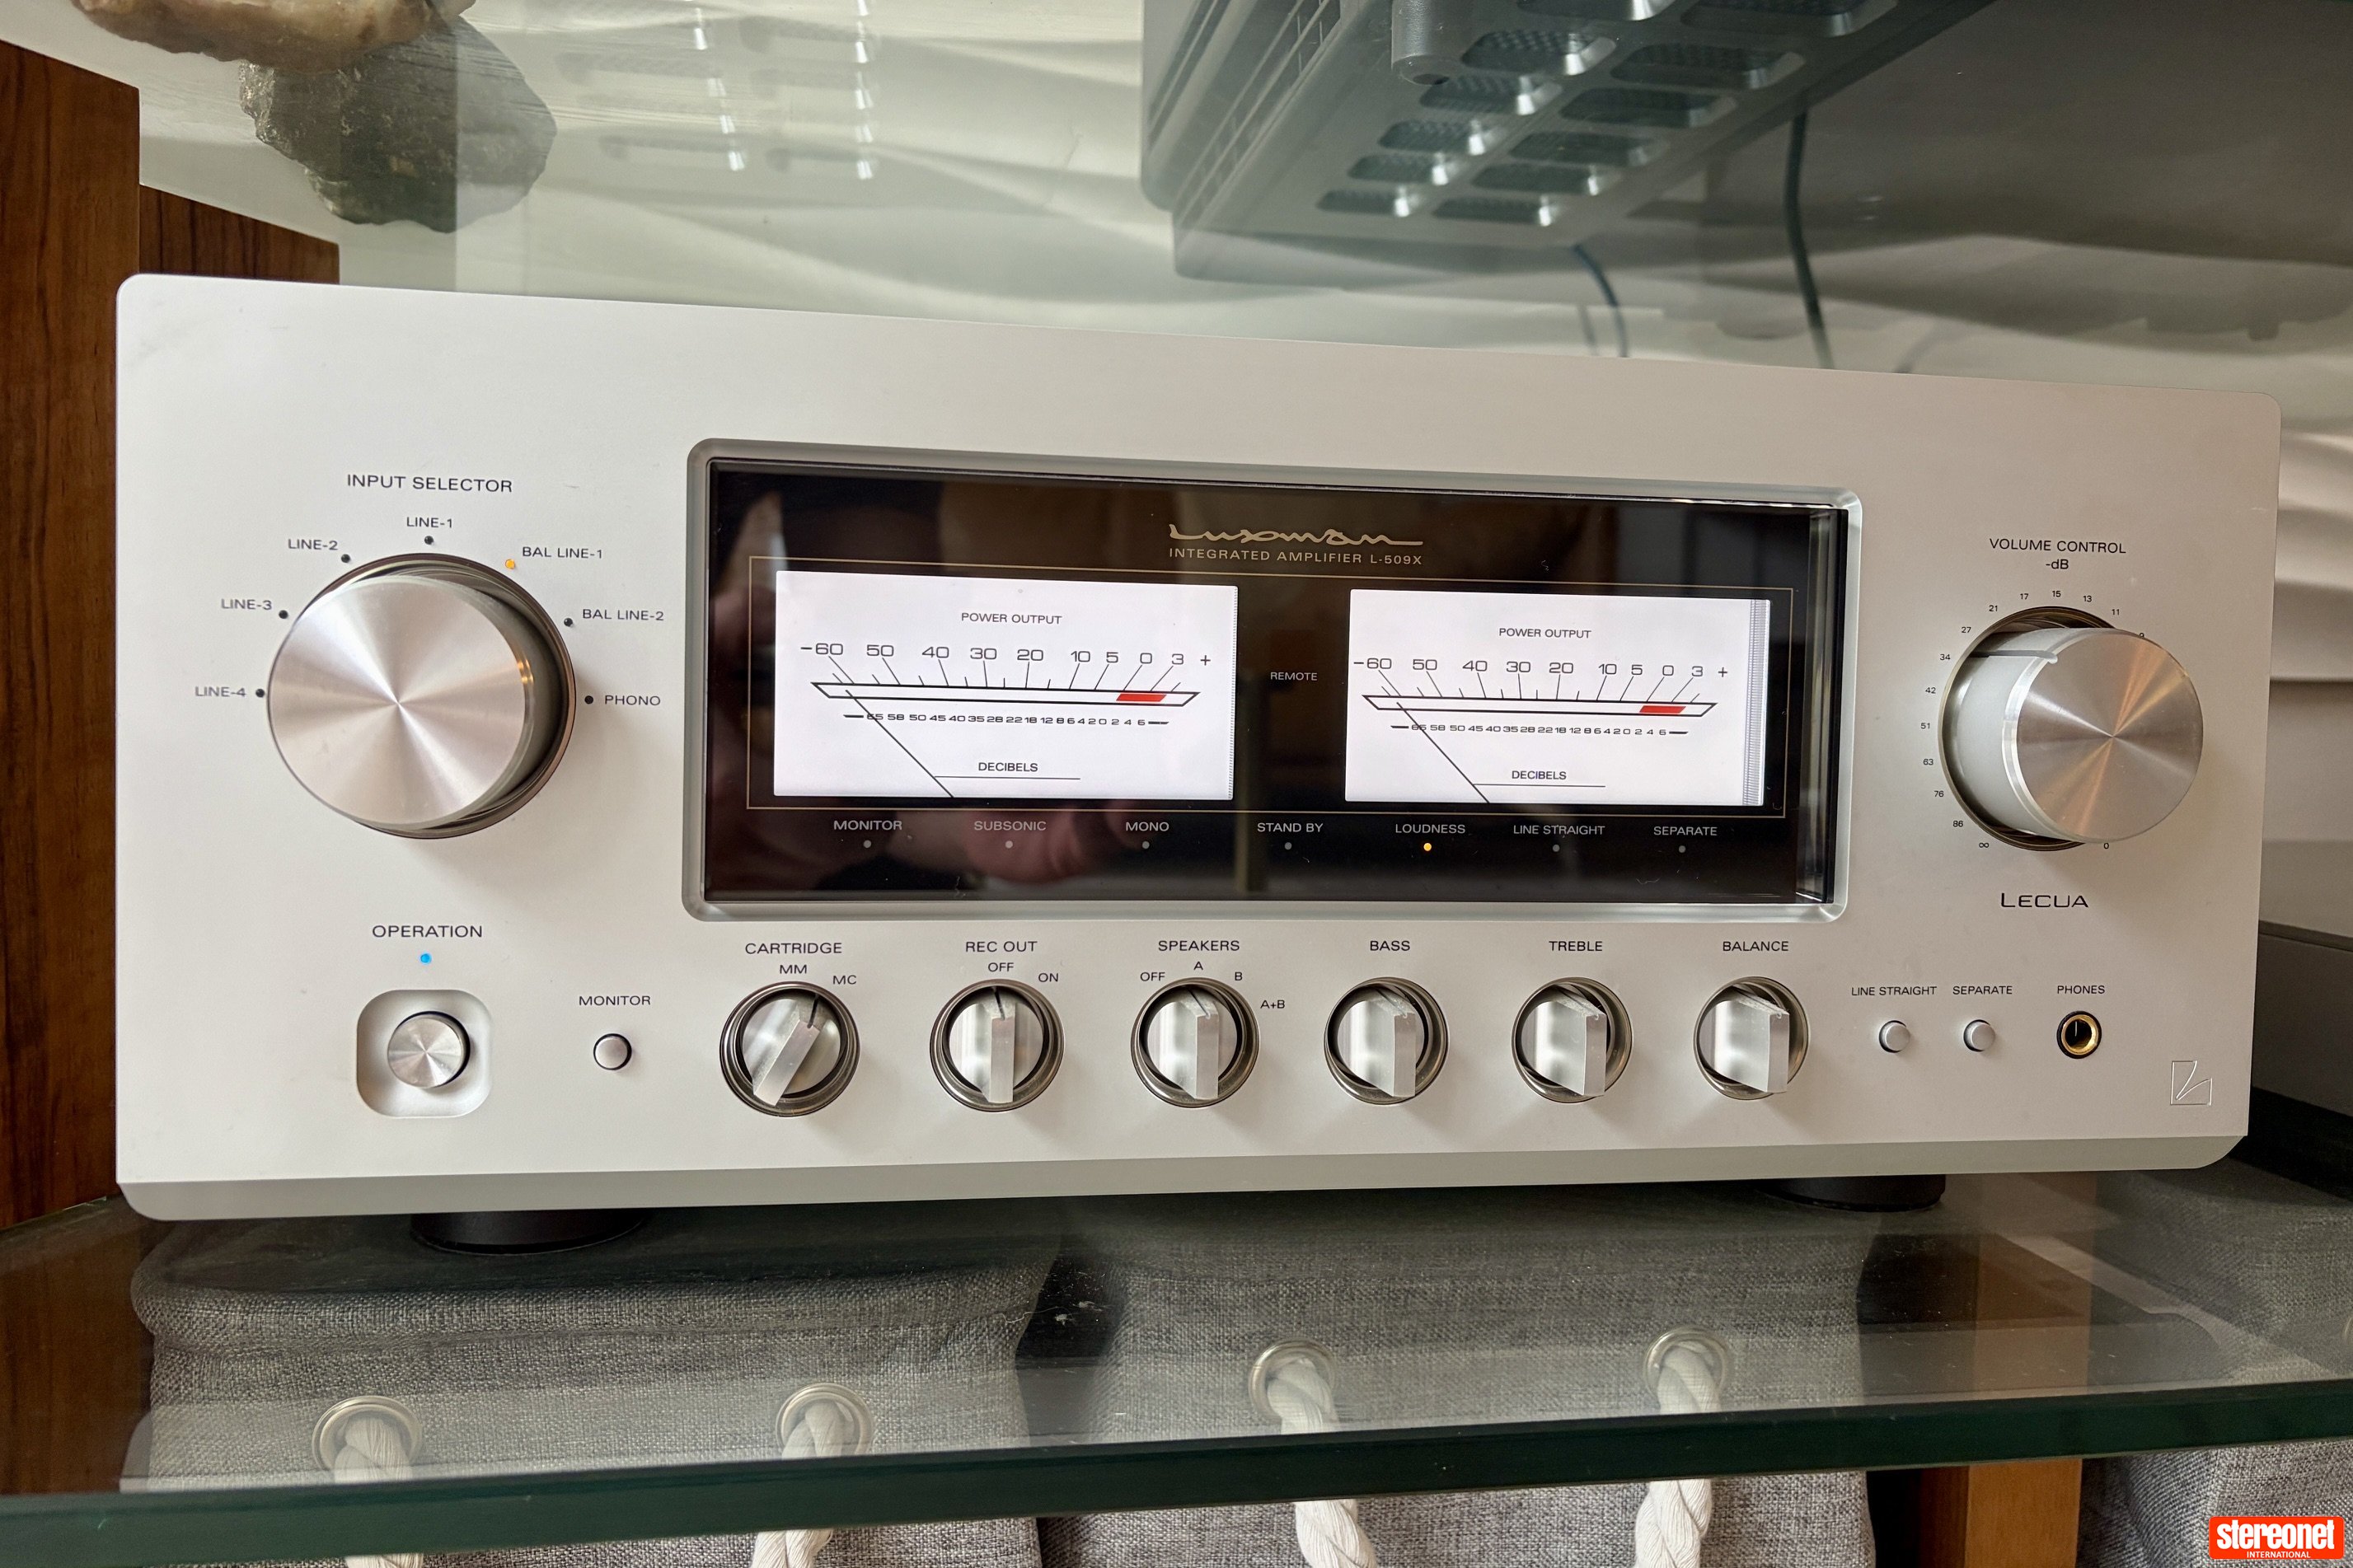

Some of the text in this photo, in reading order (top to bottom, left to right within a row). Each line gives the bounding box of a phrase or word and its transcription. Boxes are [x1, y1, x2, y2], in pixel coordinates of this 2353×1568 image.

[348, 475, 512, 492] INPUT SELECTOR
[406, 517, 452, 528] LINE-1
[288, 538, 338, 551] LINE-2
[1989, 538, 2126, 554] VOLUME CONTROL
[522, 546, 602, 559] BAL LINE-1
[1169, 548, 1422, 565] INTEGRATED AMPLIFIER L-509X
[2045, 559, 2069, 570] -dB
[2019, 592, 2029, 601] 17
[2051, 590, 2062, 598] 15
[2083, 595, 2093, 603] 13
[221, 598, 272, 611] LINE-3
[1989, 604, 1998, 612] 21
[582, 608, 664, 621] BAL LINE-2
[961, 612, 1062, 625] POWER OUTPUT
[1498, 627, 1592, 639] POWER OUTPUT
[866, 644, 894, 658] 50
[921, 646, 949, 659] 40
[969, 647, 997, 660] 30
[1016, 648, 1044, 662] 20
[1070, 650, 1091, 662] 10
[1105, 651, 1119, 663] 5
[1139, 652, 1153, 665] 0
[1171, 653, 1184, 666] 3
[1412, 658, 1438, 671] 50
[1462, 660, 1488, 672] 40
[1506, 661, 1531, 673] 30
[1549, 662, 1574, 674] 20
[1598, 663, 1617, 675] 10
[1631, 664, 1643, 676] 5
[1662, 664, 1675, 676] 0
[1691, 665, 1704, 677] 3
[1270, 672, 1318, 681] REMOTE
[195, 686, 246, 698] LINE-4
[1924, 686, 1936, 695] 42
[604, 695, 661, 706] PHONO
[909, 714, 927, 722] 50
[987, 715, 1004, 723] 28
[1024, 716, 1038, 724] 18
[1537, 726, 1554, 734] 22
[1920, 722, 1930, 730] 51
[978, 761, 1038, 773] DECIBELS
[1923, 758, 1934, 766] 63
[1512, 770, 1567, 780] DECIBELS
[833, 820, 902, 831] MONITOR
[973, 820, 1047, 831] SUBSONIC
[1125, 821, 1169, 832] MONO
[1257, 822, 1324, 833] STAND BY
[1395, 823, 1466, 834] LOUDNESS
[1952, 820, 1964, 828] 86
[1513, 824, 1605, 837] LINE STRAIGHT
[1653, 826, 1718, 836] SEPARATE
[2001, 893, 2088, 907] LECUA
[372, 924, 482, 938] OPERATION
[744, 942, 842, 955] CARTRIDGE
[965, 940, 1038, 953] REC OUT
[1158, 940, 1240, 952] SPEAKERS
[1370, 940, 1411, 952] BASS
[1548, 940, 1603, 952] TREBLE
[1723, 940, 1789, 952] BALANCE
[779, 964, 808, 975] MM
[987, 962, 1015, 972] OFF
[1193, 961, 1204, 971] A
[832, 974, 857, 985] MC
[1038, 972, 1059, 983] ON
[1140, 971, 1165, 982] OFF
[1234, 971, 1243, 981] B
[1851, 985, 1938, 996] LINE STRAIGHT
[1952, 985, 2013, 995] SEPARATE
[2057, 985, 2106, 995] PHONES
[579, 995, 651, 1006] MONITOR
[1259, 999, 1286, 1009] A+B
